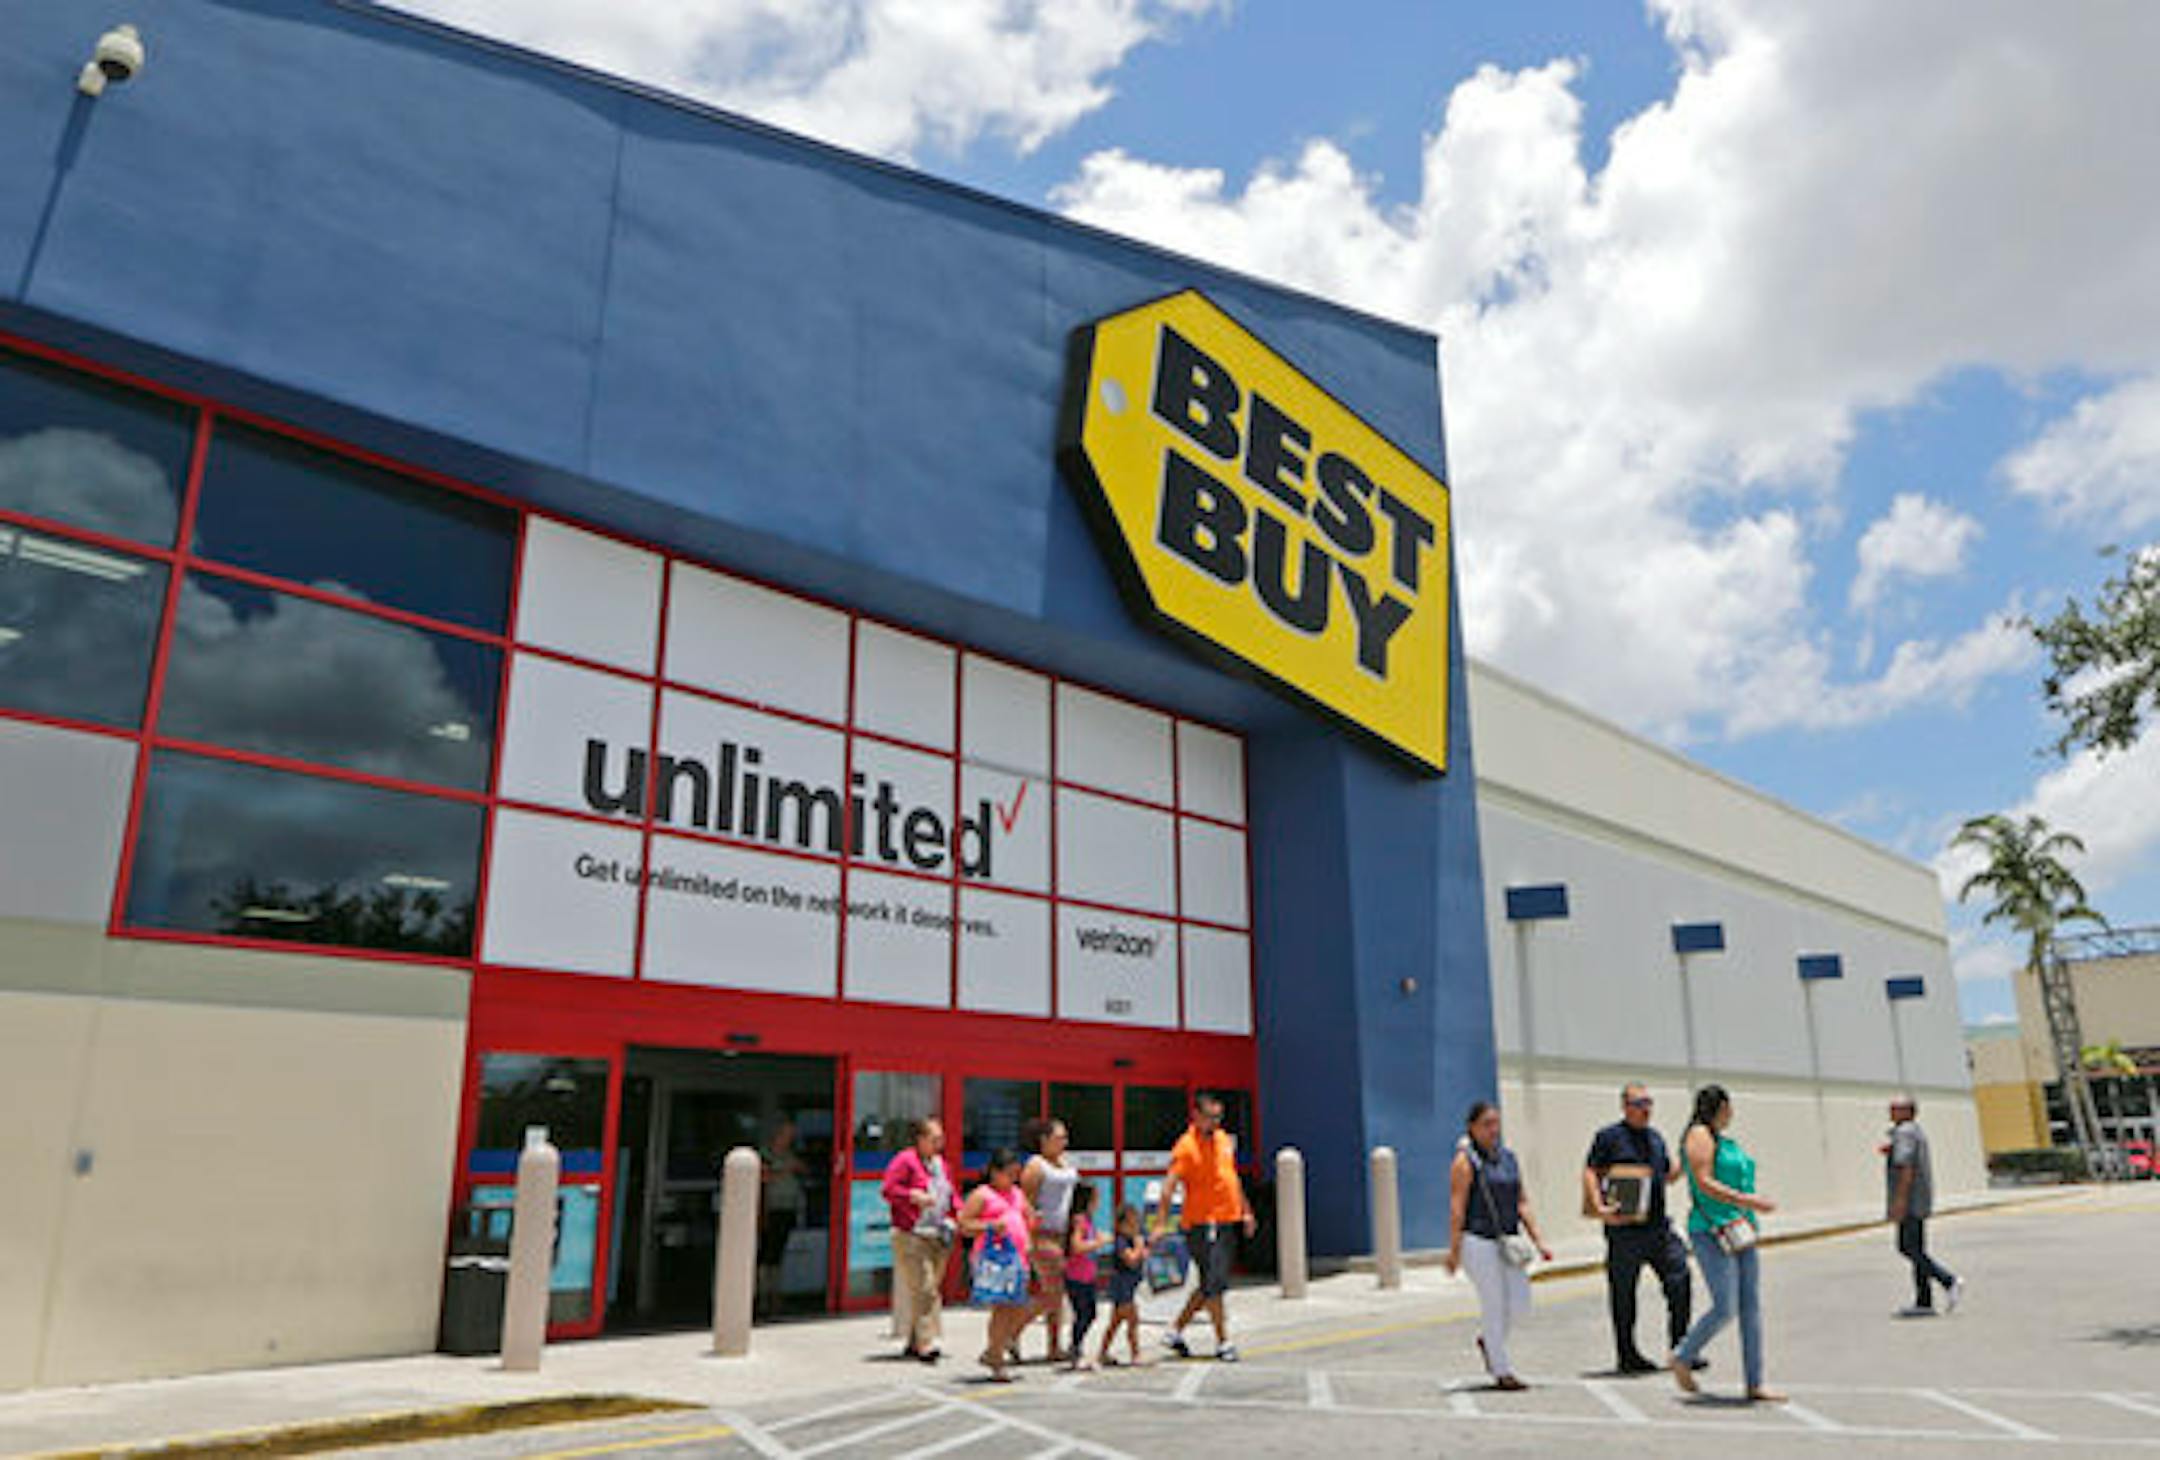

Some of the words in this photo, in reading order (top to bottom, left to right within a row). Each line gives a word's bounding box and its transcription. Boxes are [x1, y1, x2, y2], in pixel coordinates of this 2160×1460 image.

[1151, 322, 1435, 596] BEST
[1155, 446, 1414, 681] BUY
[584, 738, 992, 877] unlimited
[574, 853, 619, 883] Get
[625, 866, 737, 900] unlimited
[742, 885, 767, 904] on
[770, 886, 801, 911] the
[894, 904, 907, 925] it
[1075, 926, 1154, 958] verizon
